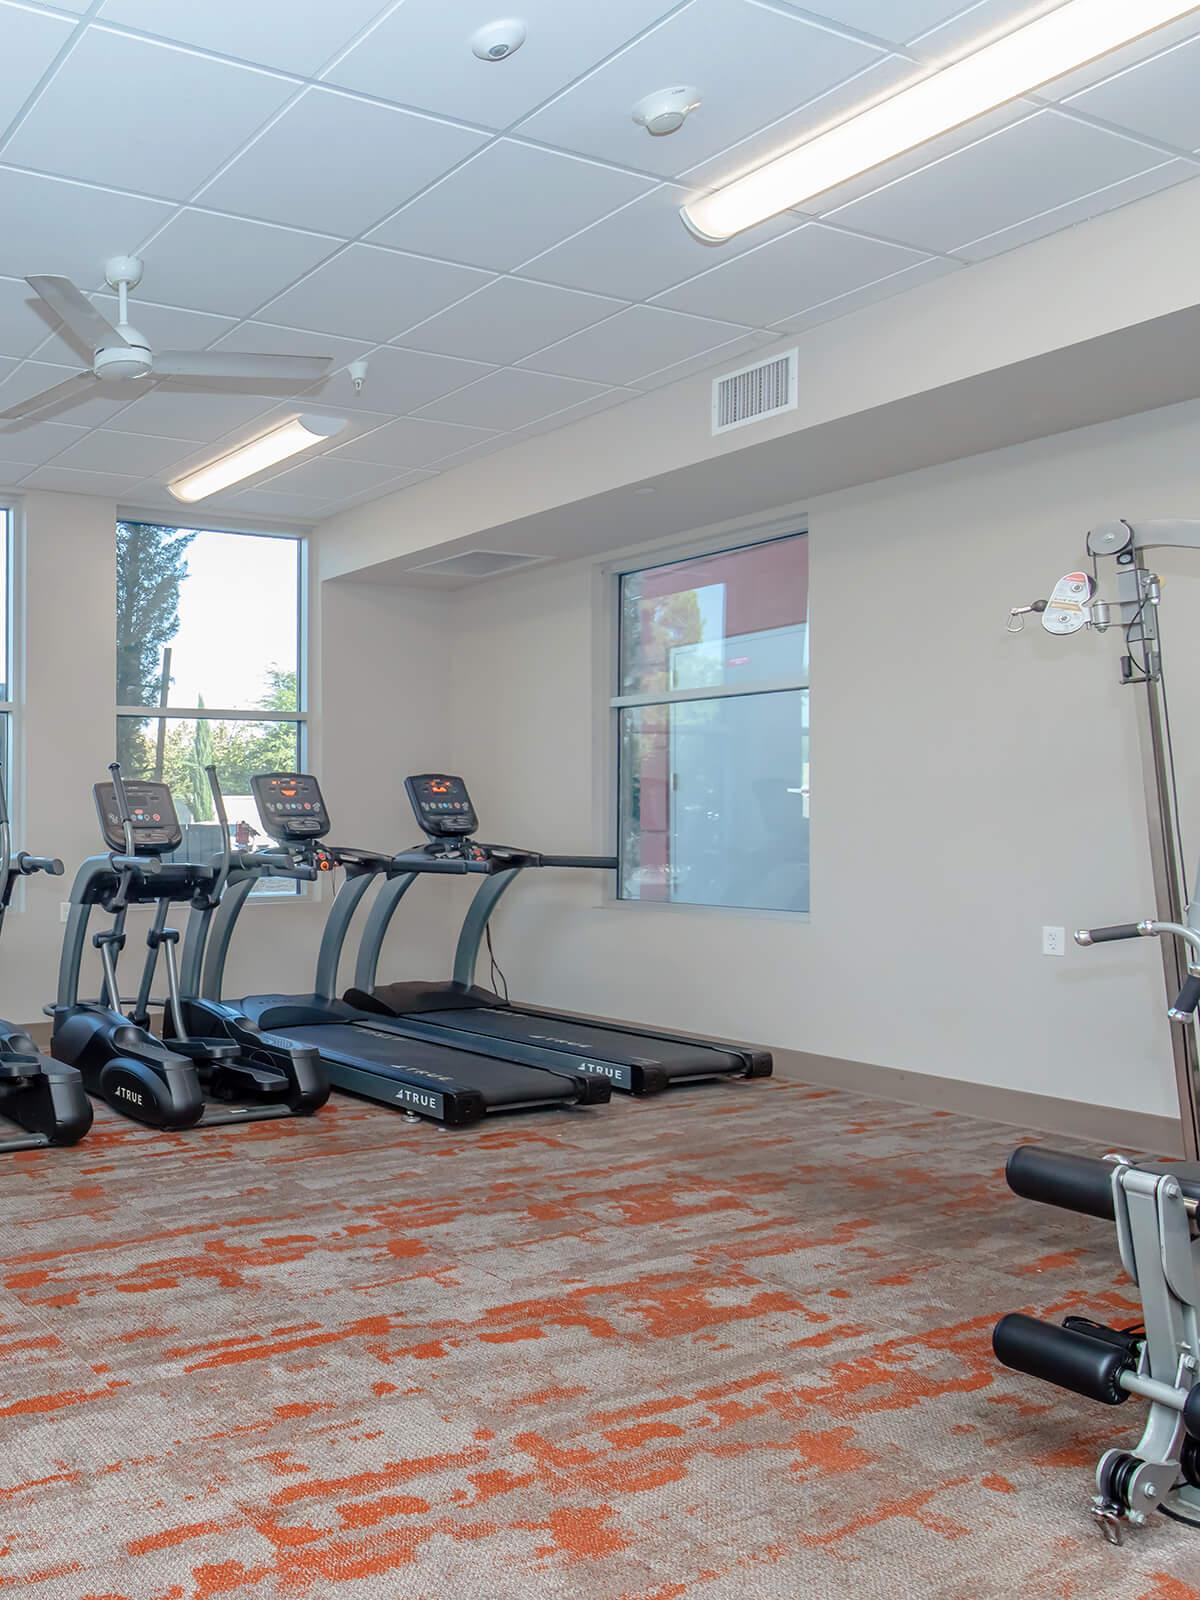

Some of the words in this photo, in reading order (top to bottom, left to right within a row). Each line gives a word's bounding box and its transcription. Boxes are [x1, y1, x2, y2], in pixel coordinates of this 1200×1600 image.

[587, 1063, 622, 1080] TRUE
[121, 1087, 143, 1106] TRUE
[404, 1090, 437, 1109] TRUE
